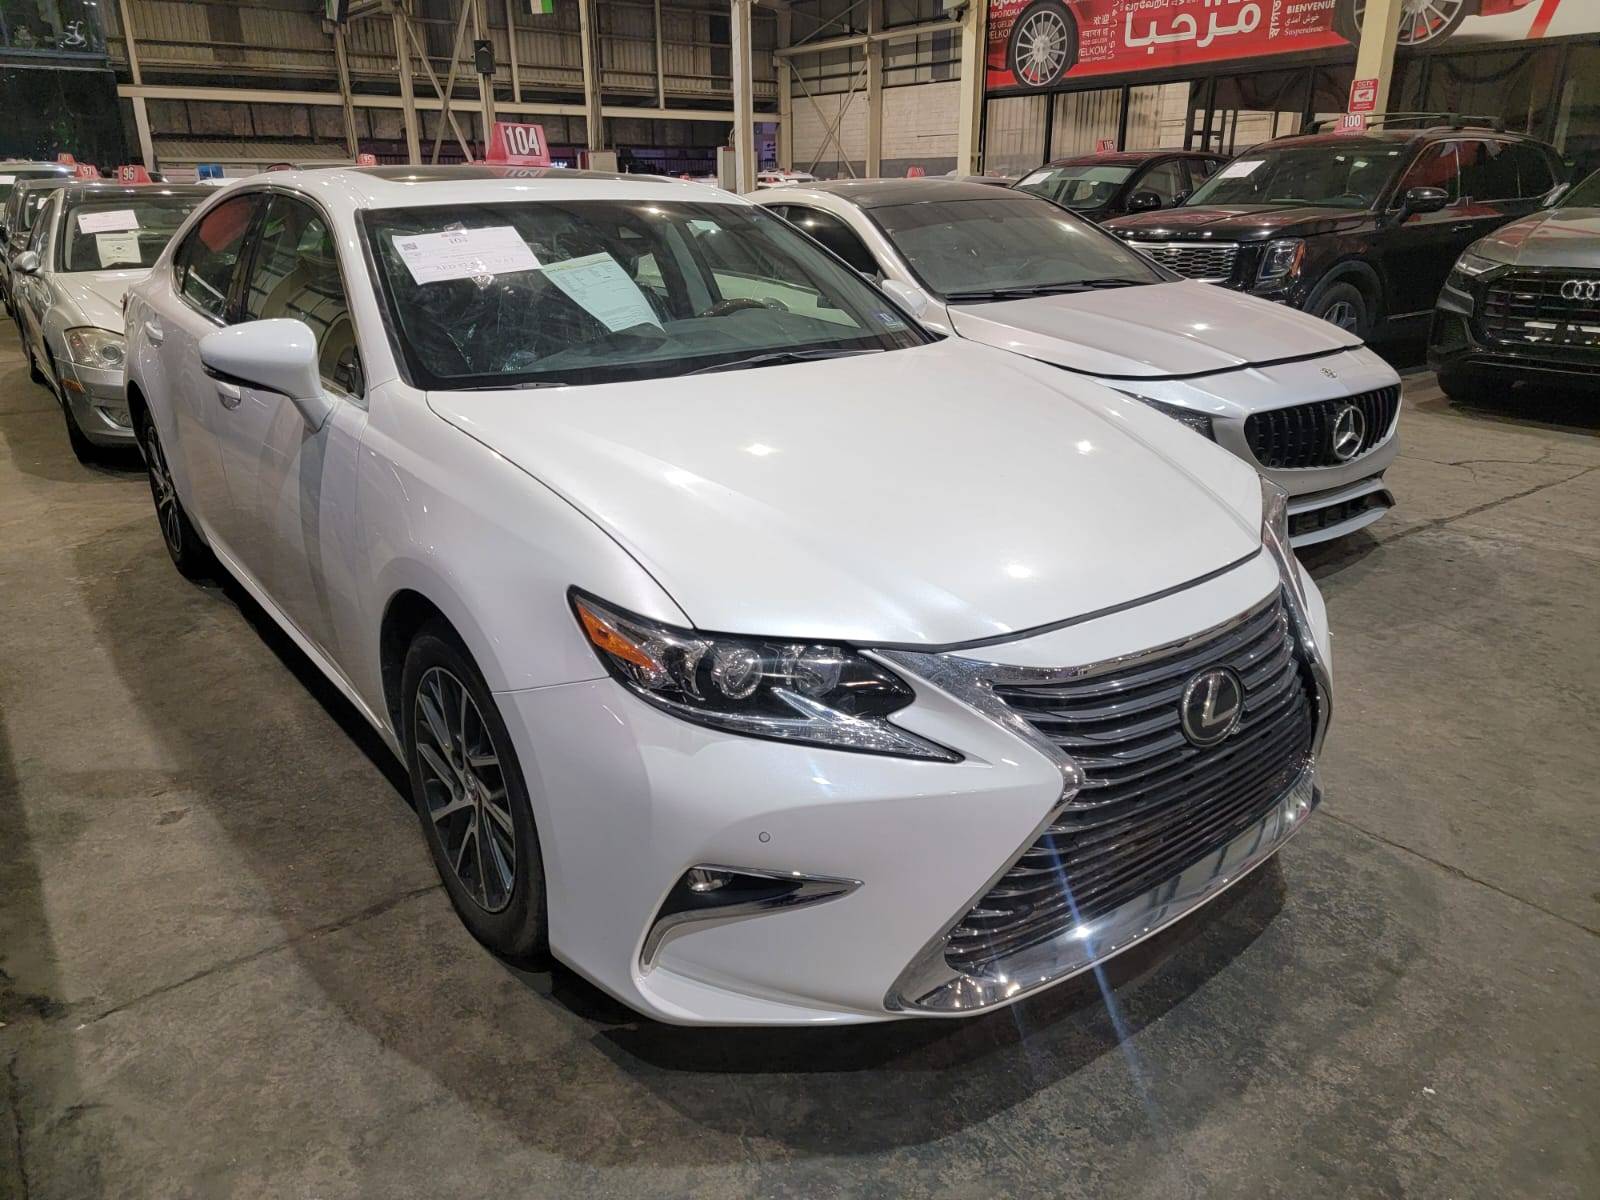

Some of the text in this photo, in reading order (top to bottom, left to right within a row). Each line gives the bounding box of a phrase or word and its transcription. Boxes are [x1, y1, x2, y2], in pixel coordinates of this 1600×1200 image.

[1286, 0, 1337, 14] BIENVENUE
[1124, 3, 1261, 55] مرحبا
[1344, 114, 1361, 128] 100
[506, 126, 541, 156] 104
[123, 167, 134, 180] 96
